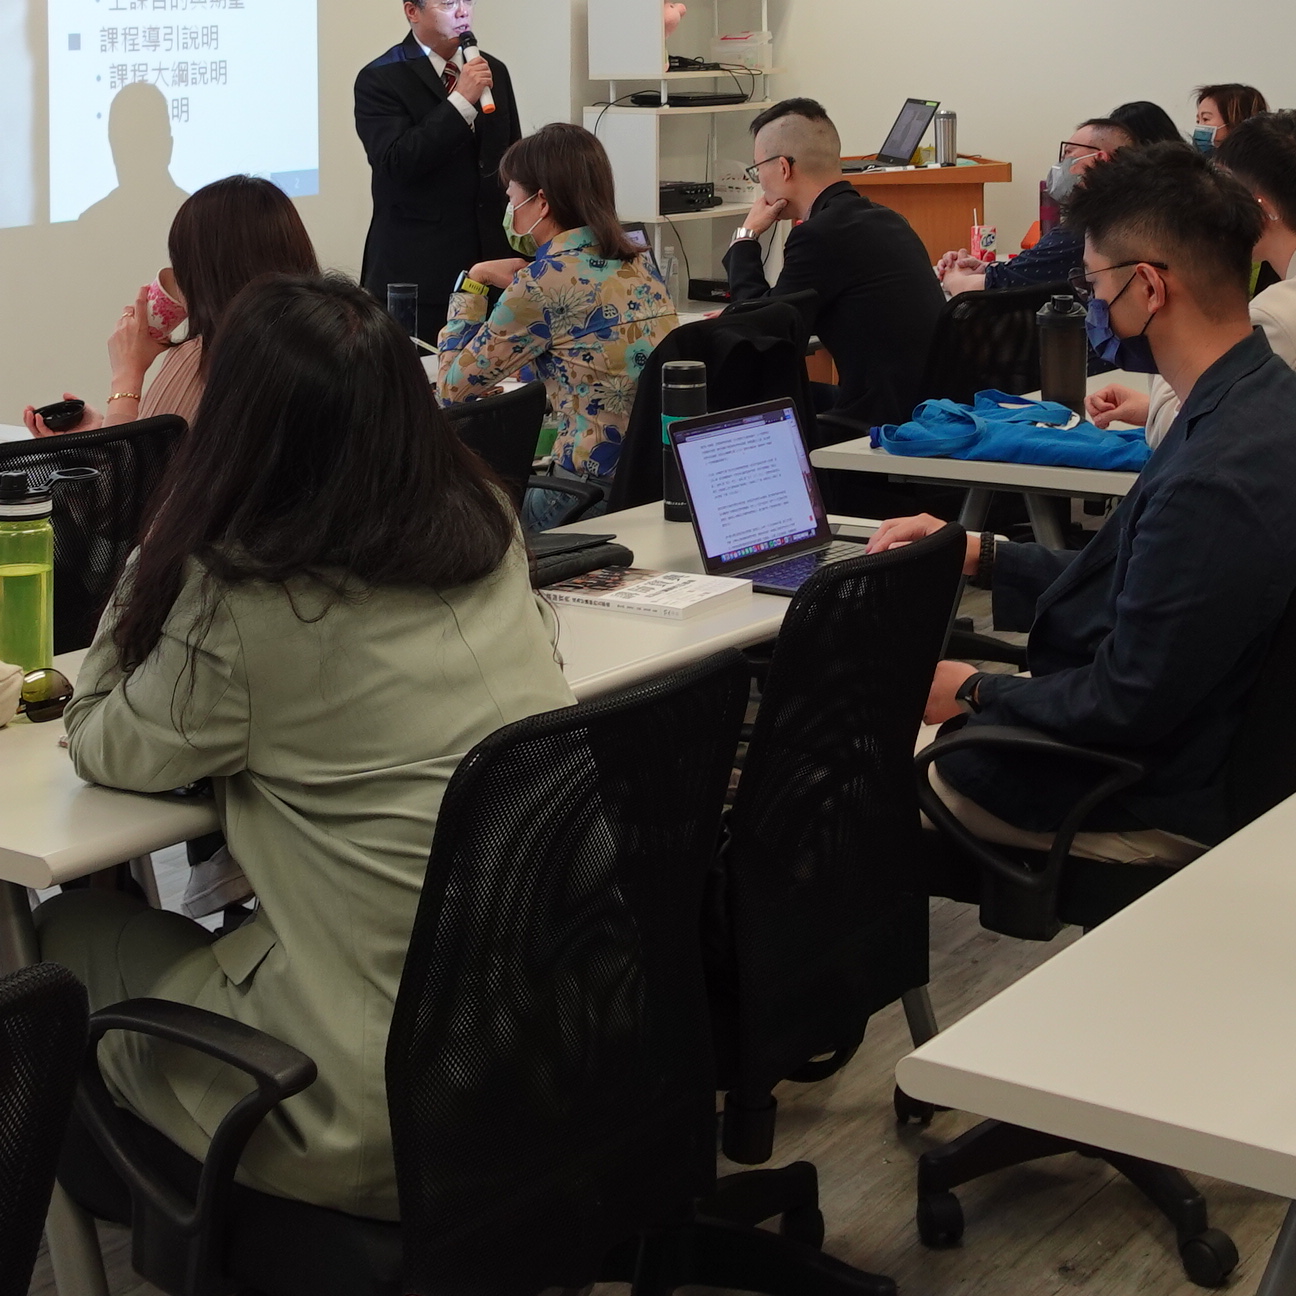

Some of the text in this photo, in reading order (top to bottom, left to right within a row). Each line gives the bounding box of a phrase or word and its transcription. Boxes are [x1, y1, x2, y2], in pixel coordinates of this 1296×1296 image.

[99, 25, 219, 53] 課程導引說明
